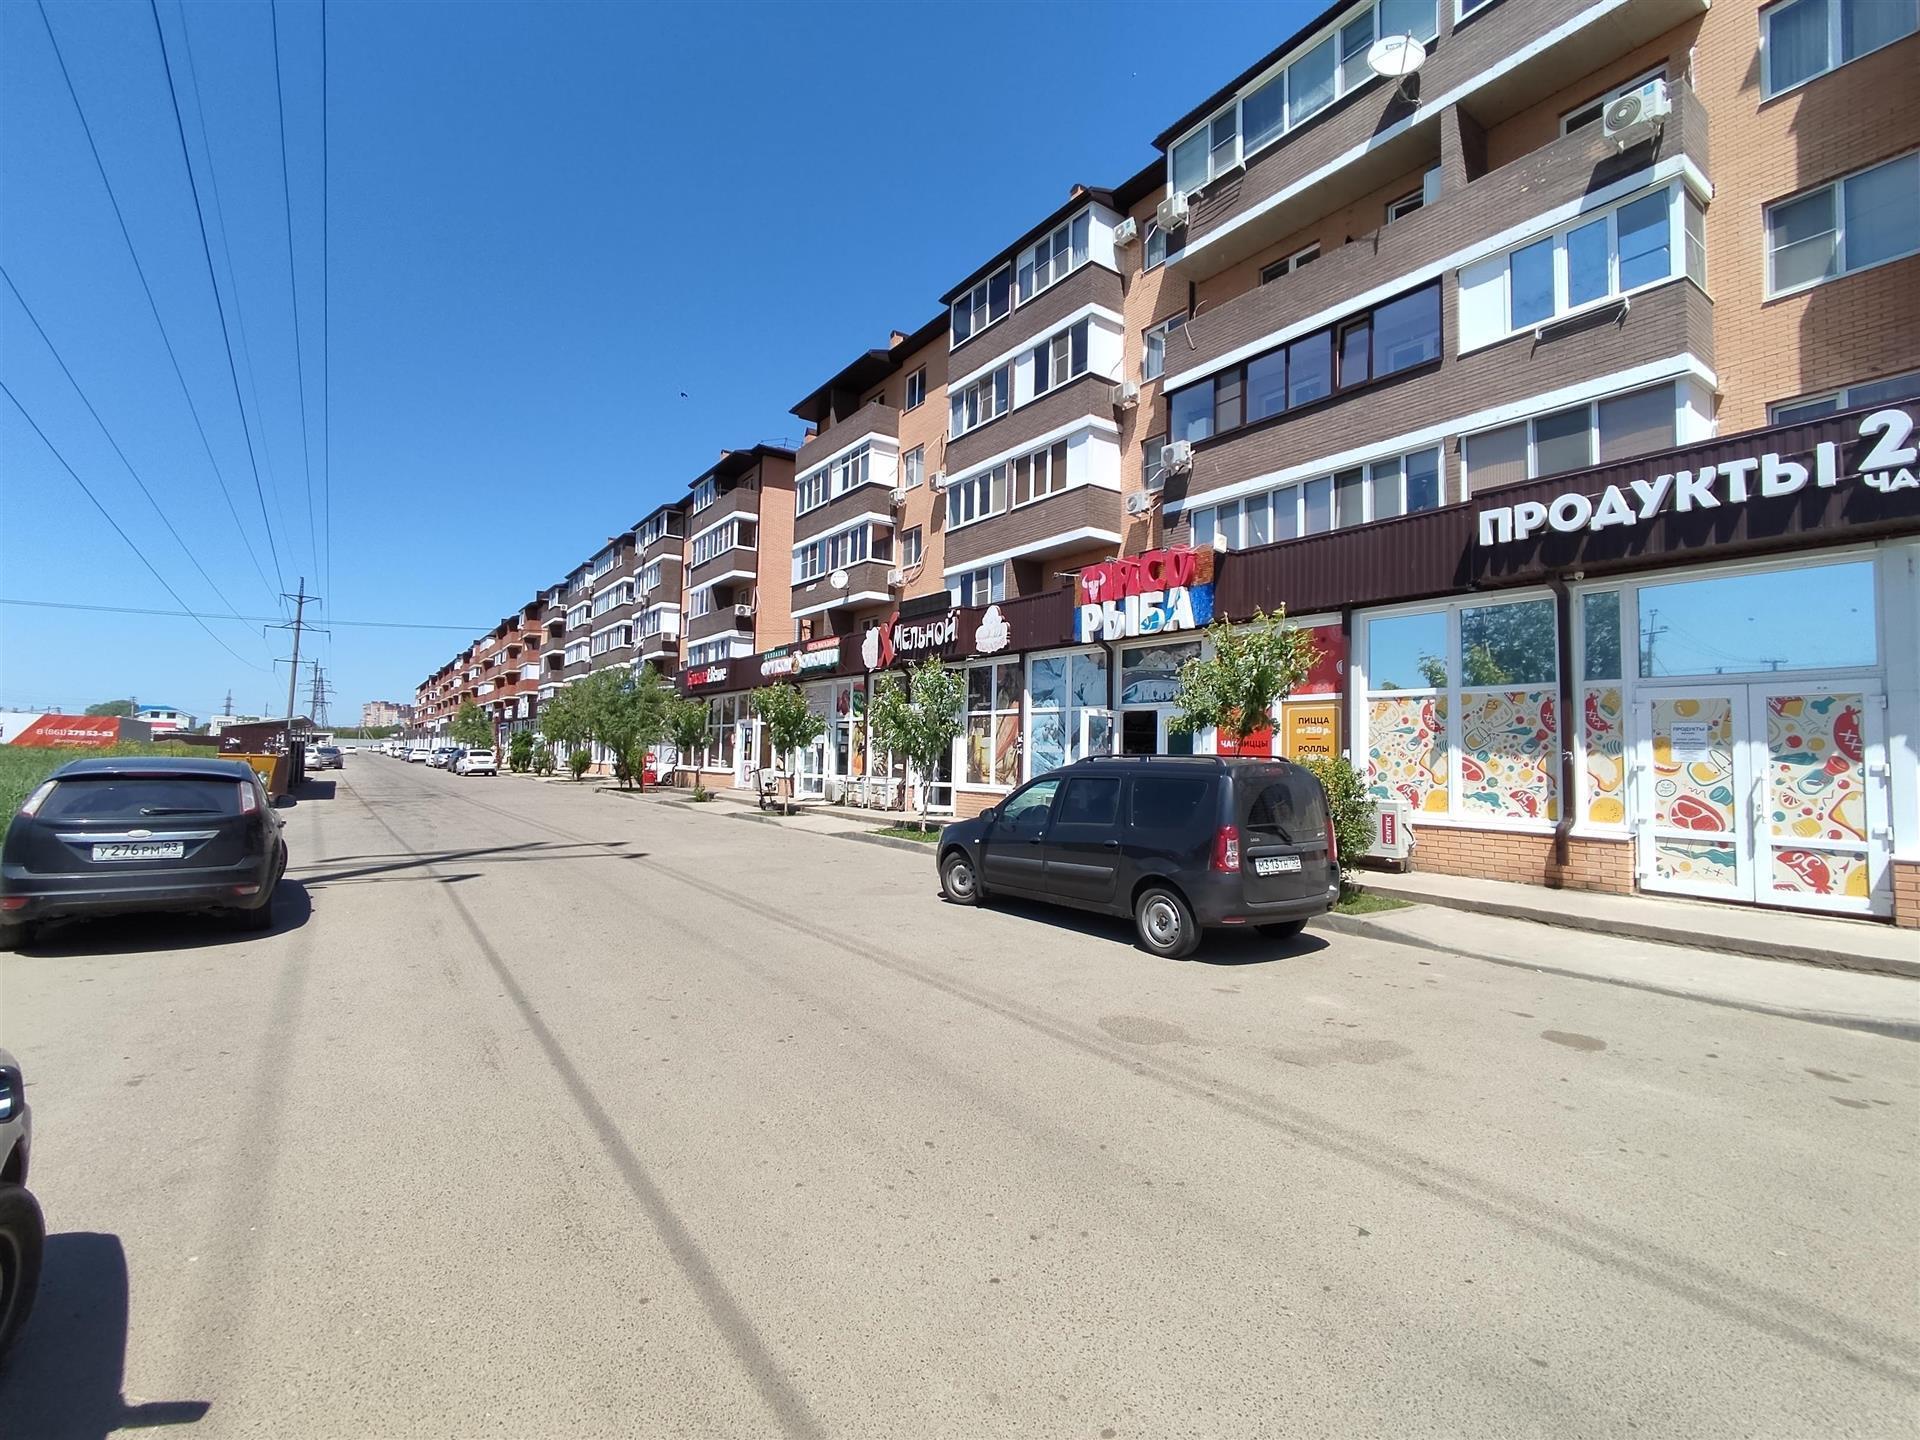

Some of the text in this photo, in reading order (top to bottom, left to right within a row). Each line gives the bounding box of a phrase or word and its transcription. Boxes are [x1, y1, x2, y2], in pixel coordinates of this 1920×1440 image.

[1478, 409, 1920, 546] ПРОДУКТЫ 2
[1864, 468, 1920, 493] ЧА
[1081, 545, 1196, 604] МЯСО
[1081, 586, 1196, 644] РЫБА
[1298, 717, 1330, 725] ПИЦЦА
[1240, 740, 1268, 749] ИЦЦЫ
